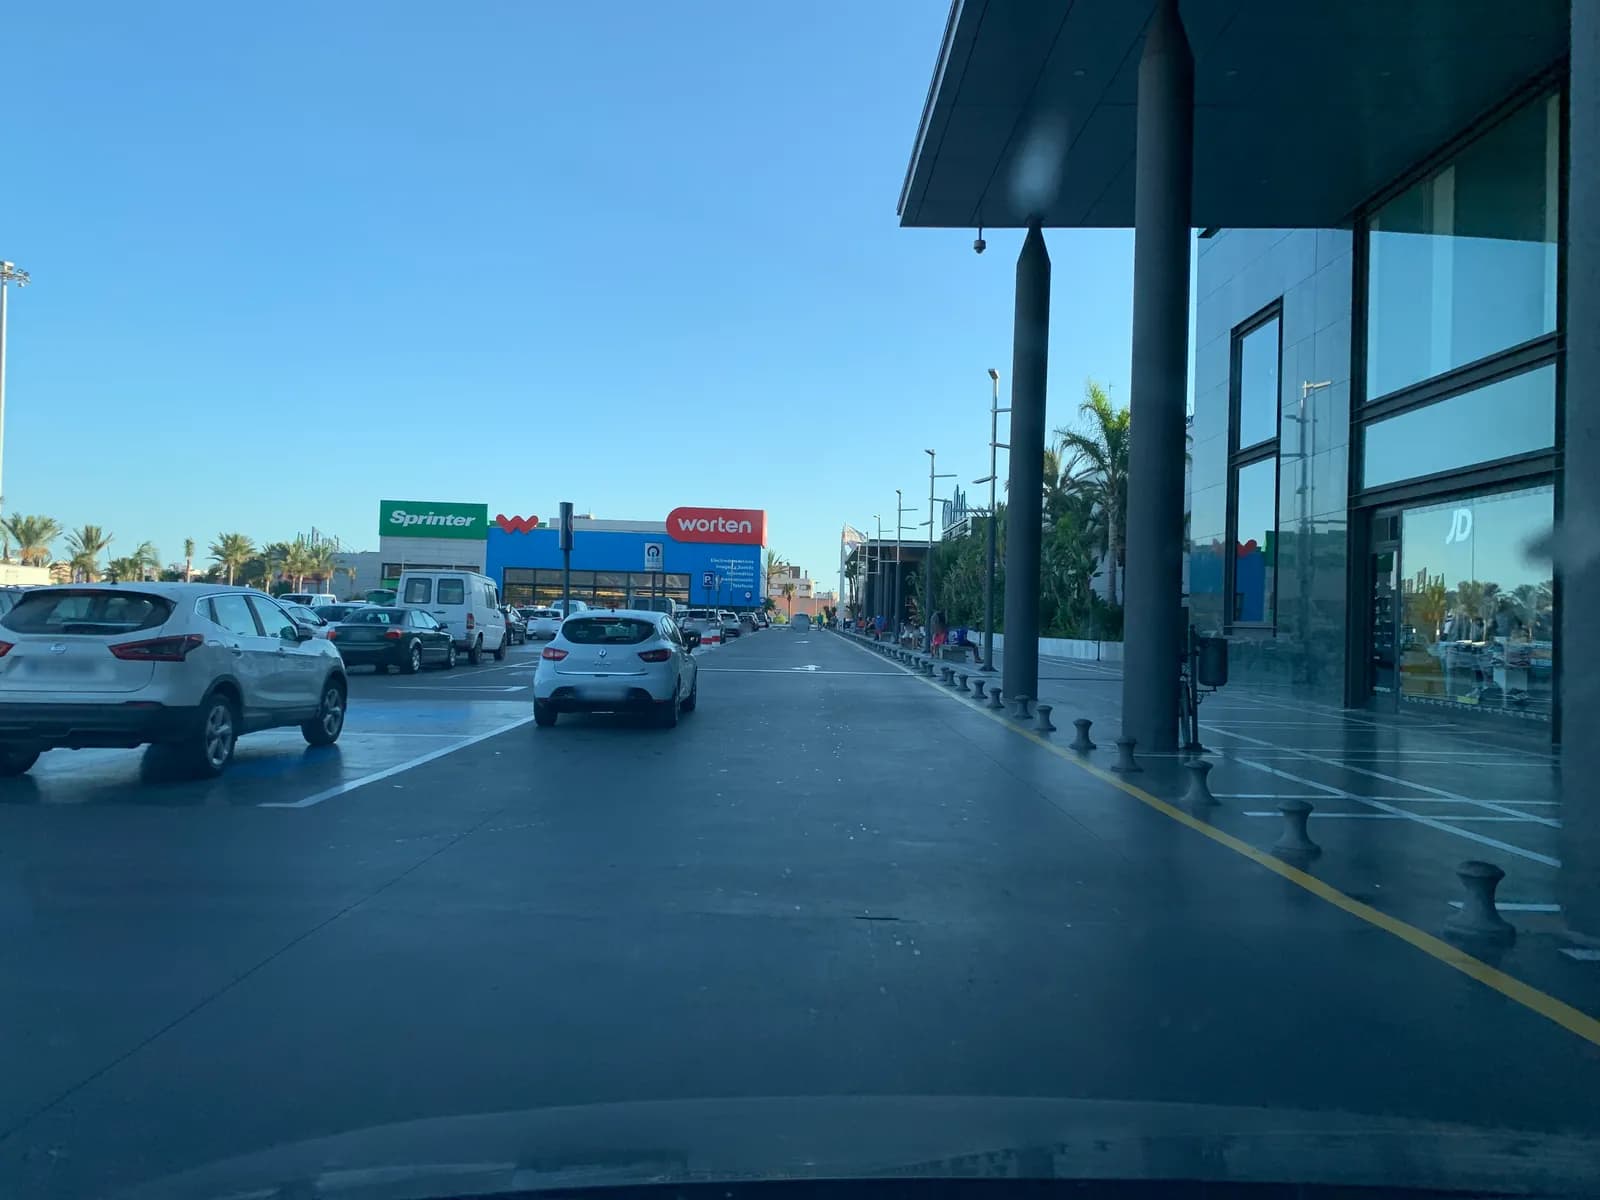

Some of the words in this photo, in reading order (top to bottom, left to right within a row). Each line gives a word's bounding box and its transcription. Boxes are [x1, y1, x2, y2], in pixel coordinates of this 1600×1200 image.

[389, 510, 475, 527] Sprinter
[677, 516, 752, 533] worten
[1446, 508, 1473, 544] JD
